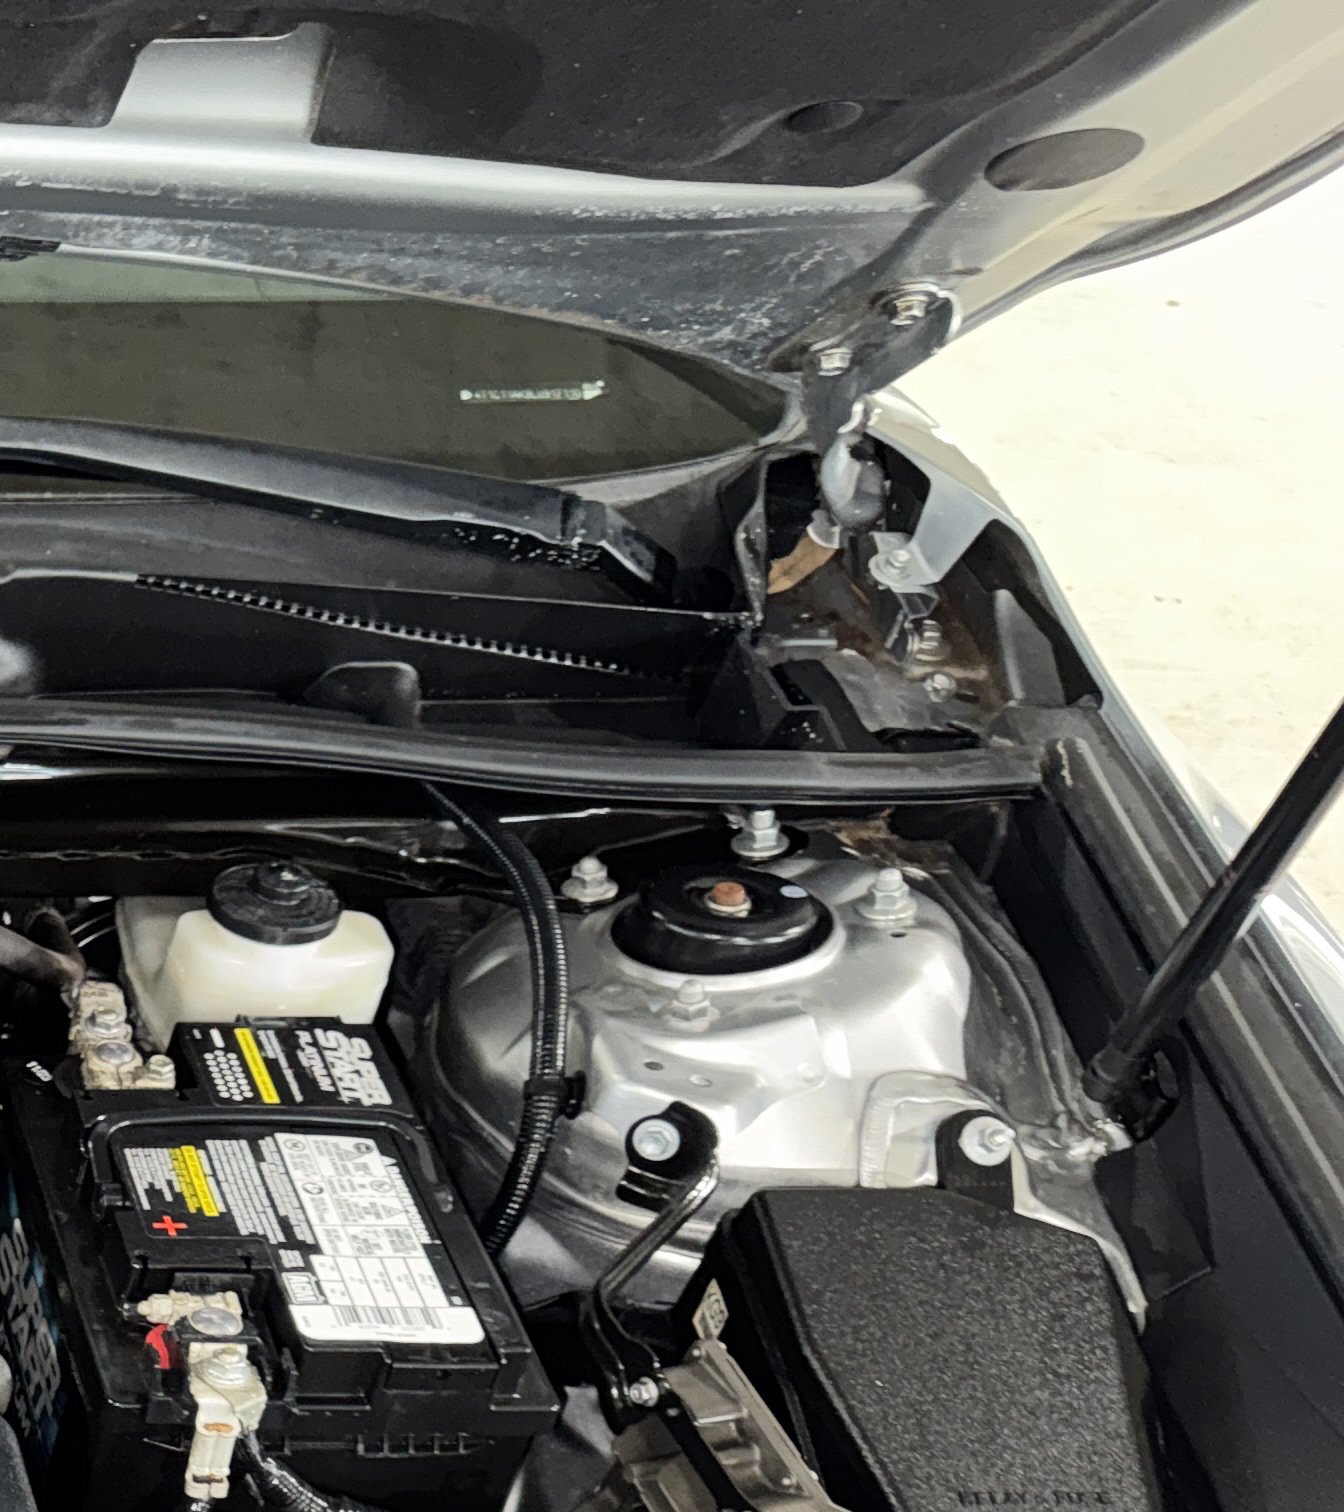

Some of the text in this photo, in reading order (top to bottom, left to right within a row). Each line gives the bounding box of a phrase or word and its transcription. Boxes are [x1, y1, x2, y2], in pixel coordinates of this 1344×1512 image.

[294, 1030, 336, 1092] PLATINUM
[314, 1028, 362, 1103] START
[349, 1037, 393, 1106] SUPER
[10, 1217, 62, 1416] SUPER
[1052, 1489, 1112, 1506] FUE
